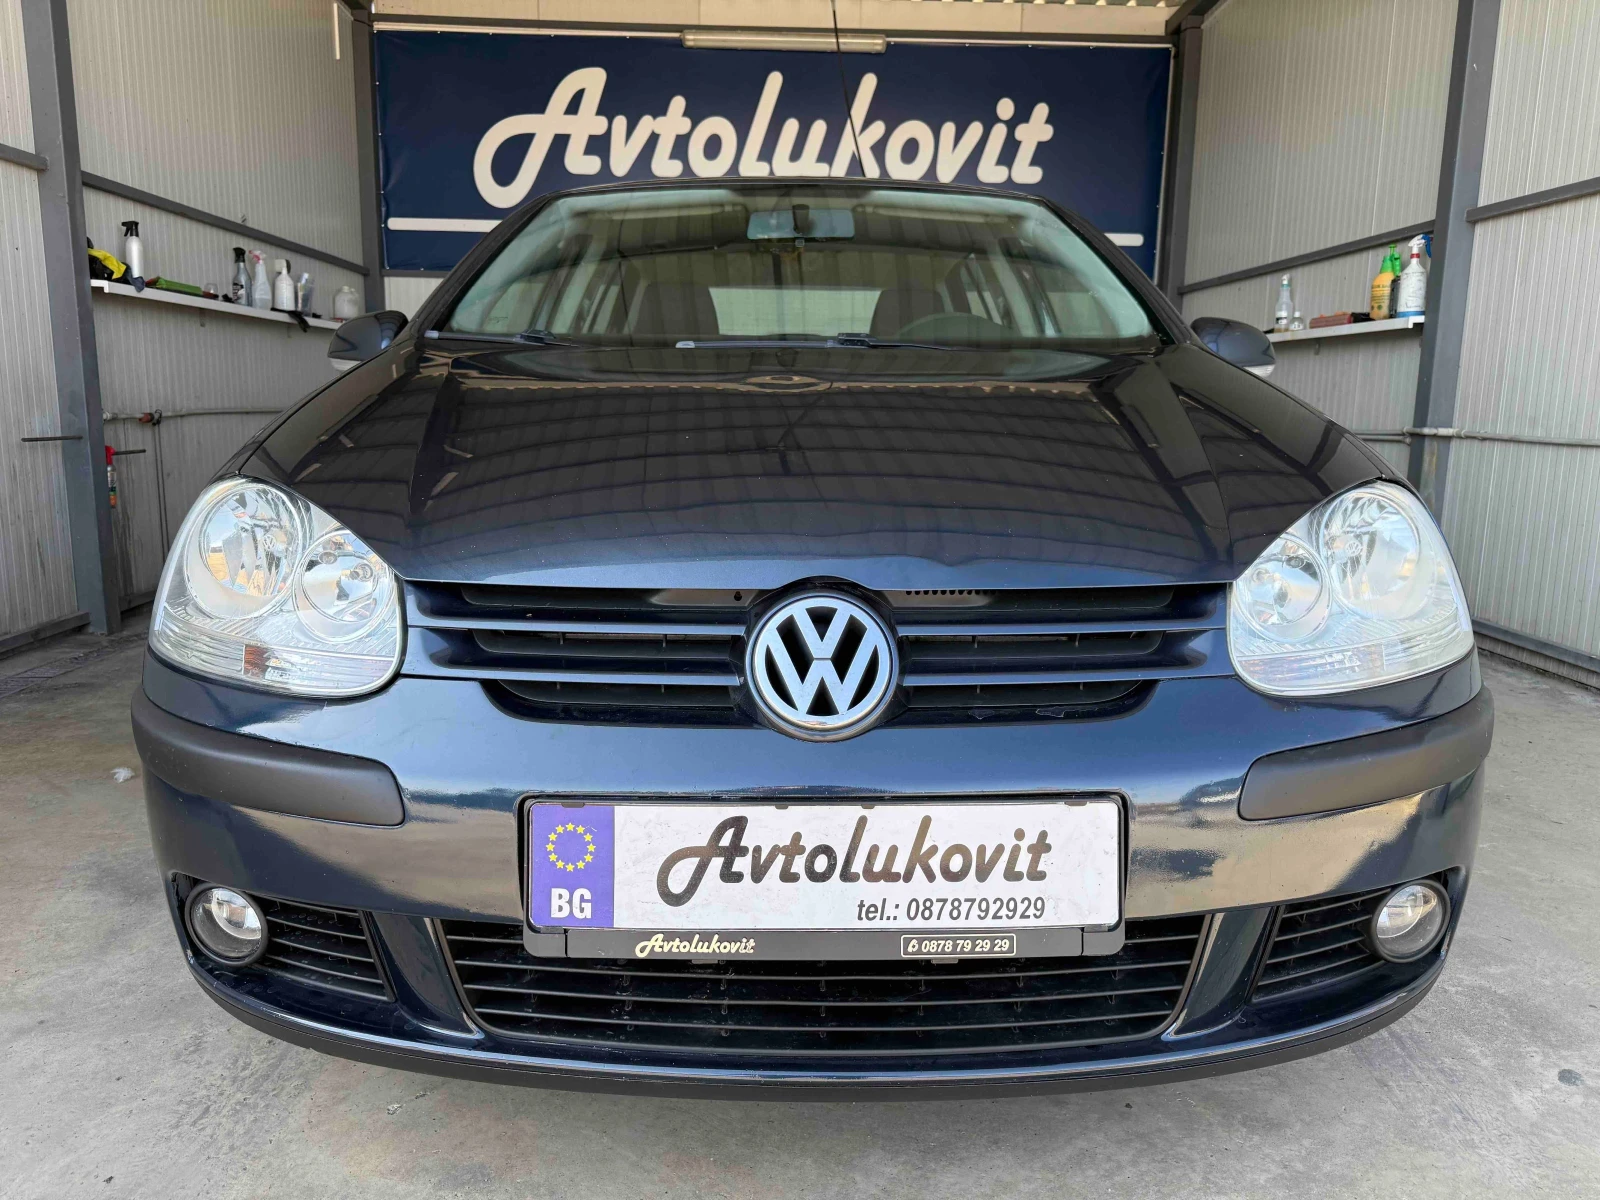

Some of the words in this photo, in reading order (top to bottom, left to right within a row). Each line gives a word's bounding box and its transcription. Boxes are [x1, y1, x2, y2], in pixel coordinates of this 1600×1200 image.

[473, 66, 1055, 208] Avtolukovit
[754, 598, 891, 729] VW
[656, 815, 1052, 907] Avtolukovit
[549, 887, 592, 920] BG
[856, 898, 899, 921] tel.:
[906, 896, 1046, 920] 0878792929
[635, 933, 756, 958] Avtolukovit
[921, 939, 954, 954] 0878
[956, 939, 972, 953] 79
[974, 939, 991, 952] 29
[993, 938, 1010, 953] 29
